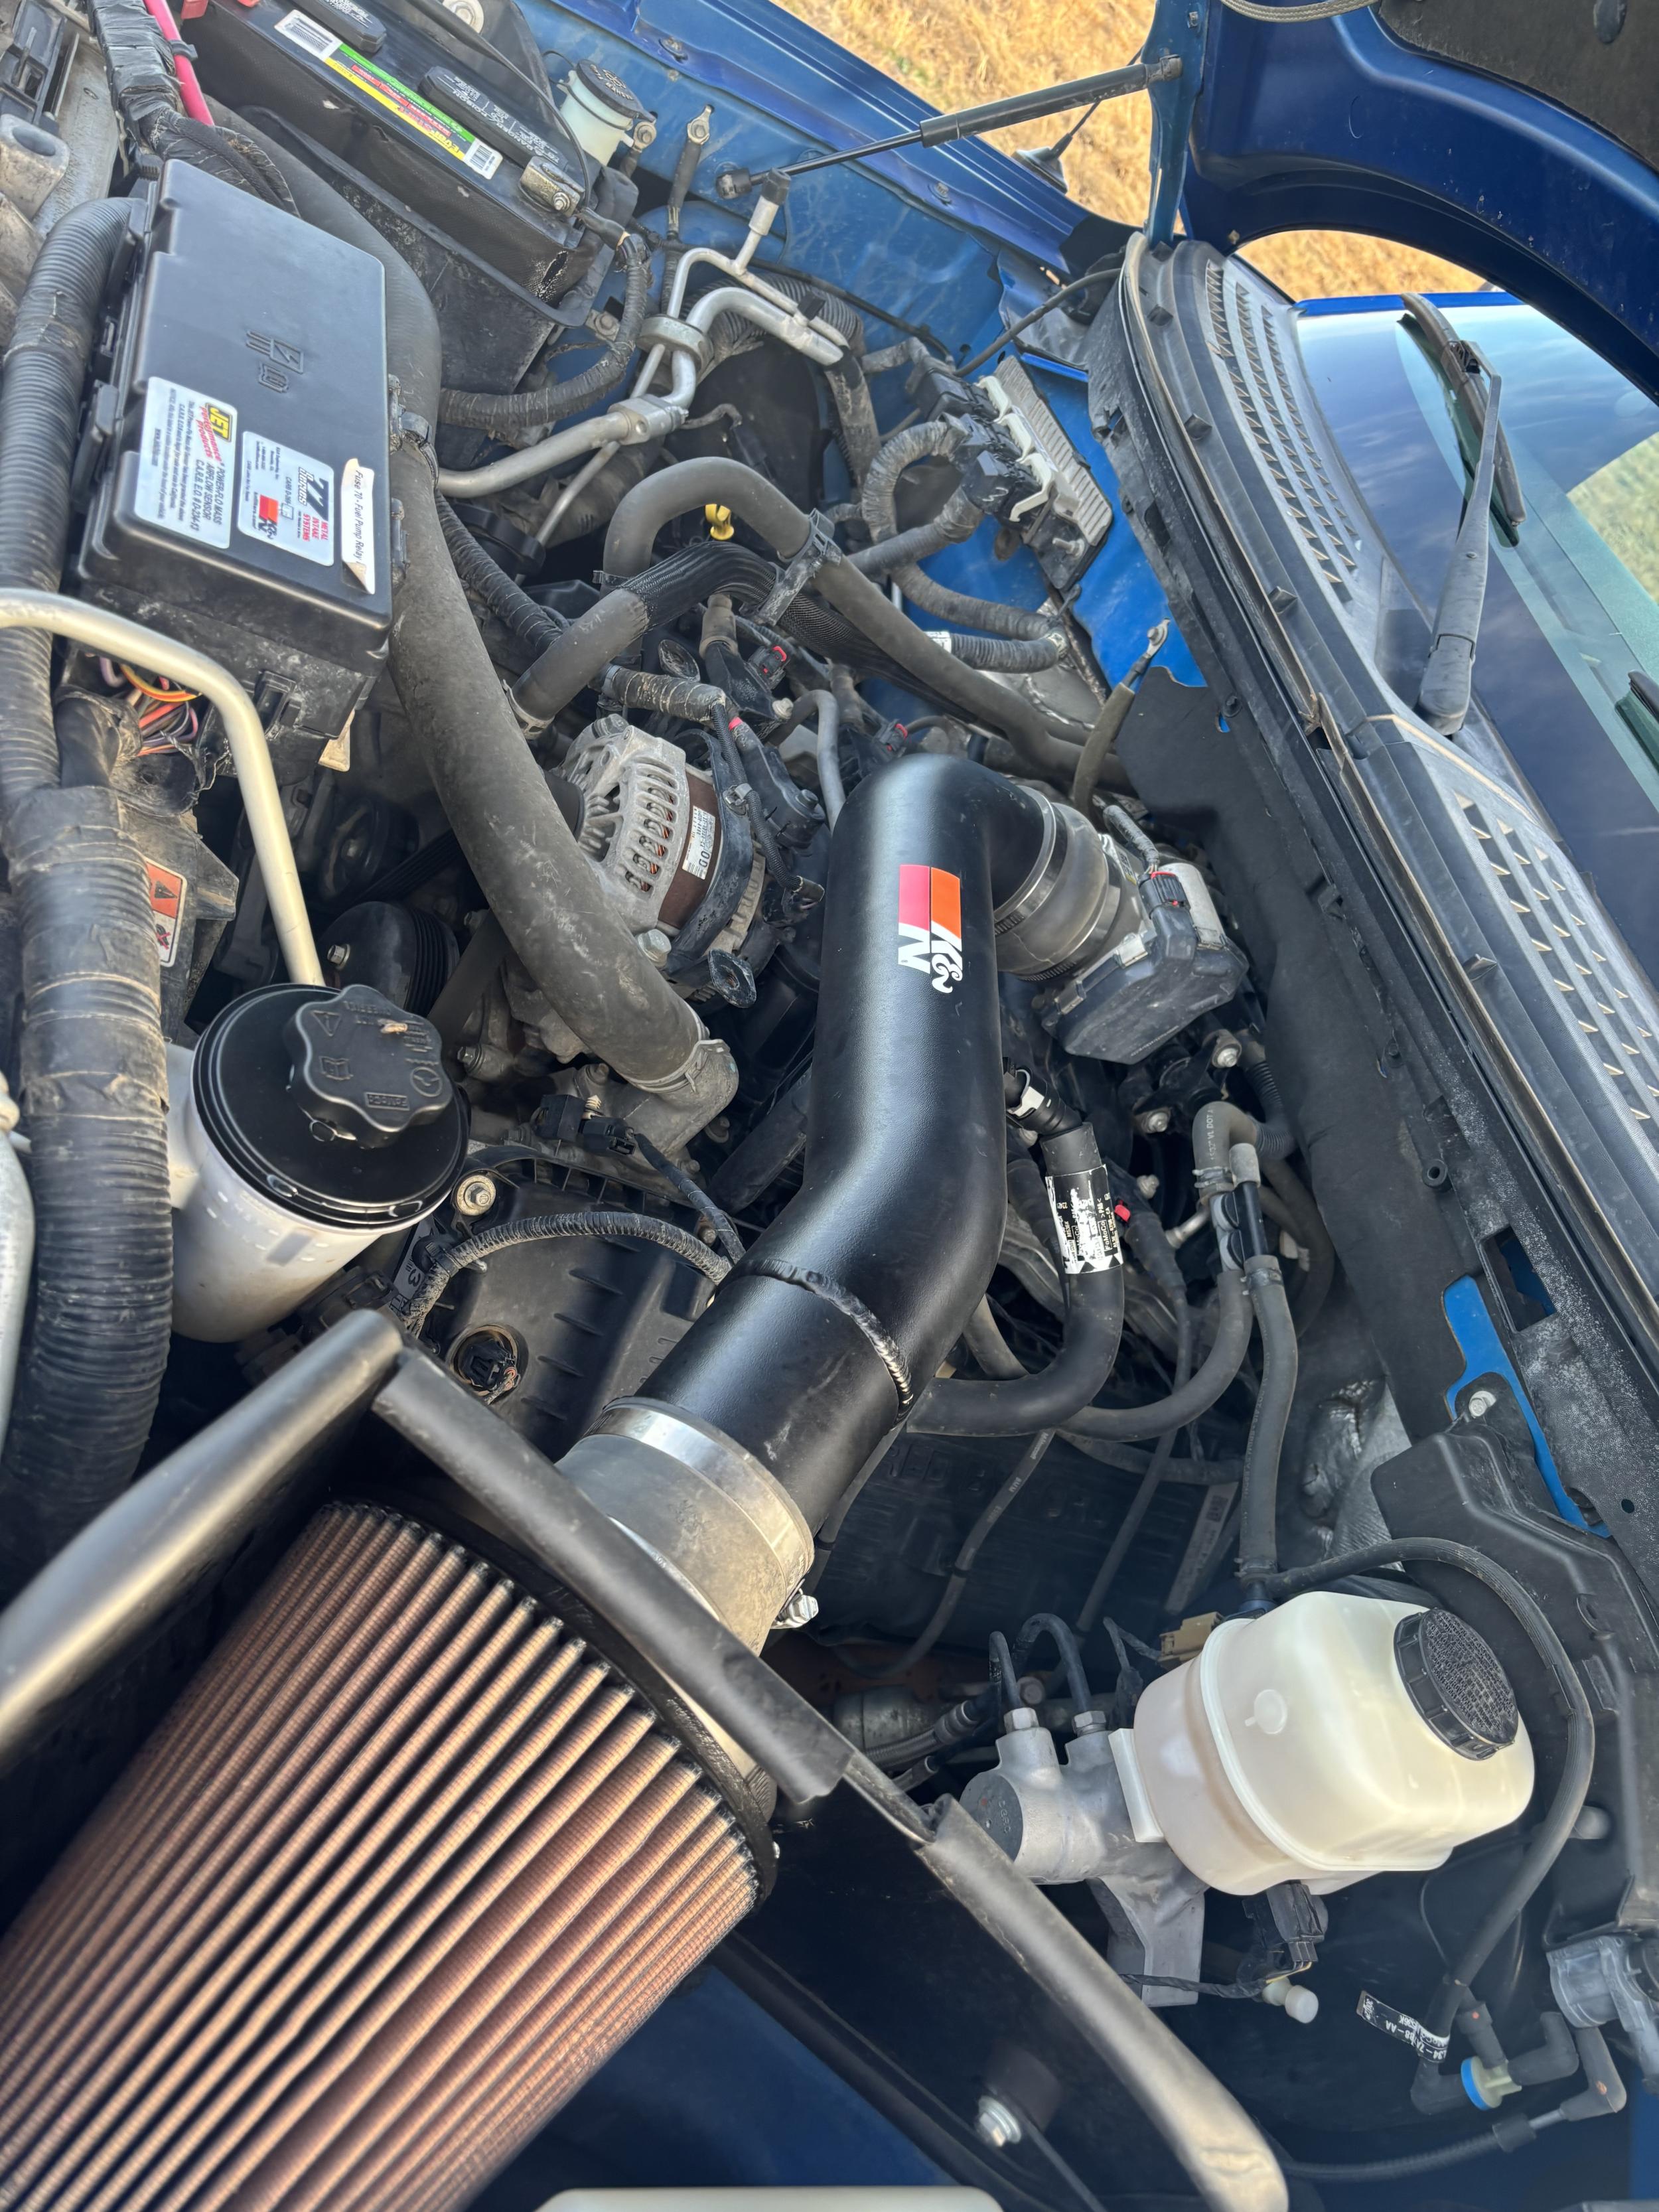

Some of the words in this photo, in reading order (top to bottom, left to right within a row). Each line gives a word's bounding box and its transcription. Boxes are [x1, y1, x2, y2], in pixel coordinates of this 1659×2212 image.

[208, 407, 229, 439] JET
[204, 462, 216, 492] AIRFLOW
[214, 466, 225, 504] POWER-FLO
[201, 491, 213, 520] SENSOR
[304, 476, 329, 522] 77
[354, 490, 363, 499] 70
[212, 504, 222, 525] MASS
[354, 503, 363, 518] Fuel
[301, 512, 311, 542] SYSTEMS
[311, 516, 319, 539] INTAKE
[320, 520, 328, 541] METAL
[352, 518, 362, 539] Pump
[352, 540, 362, 560] Relay
[1099, 1219, 1112, 1250] FoMoCo
